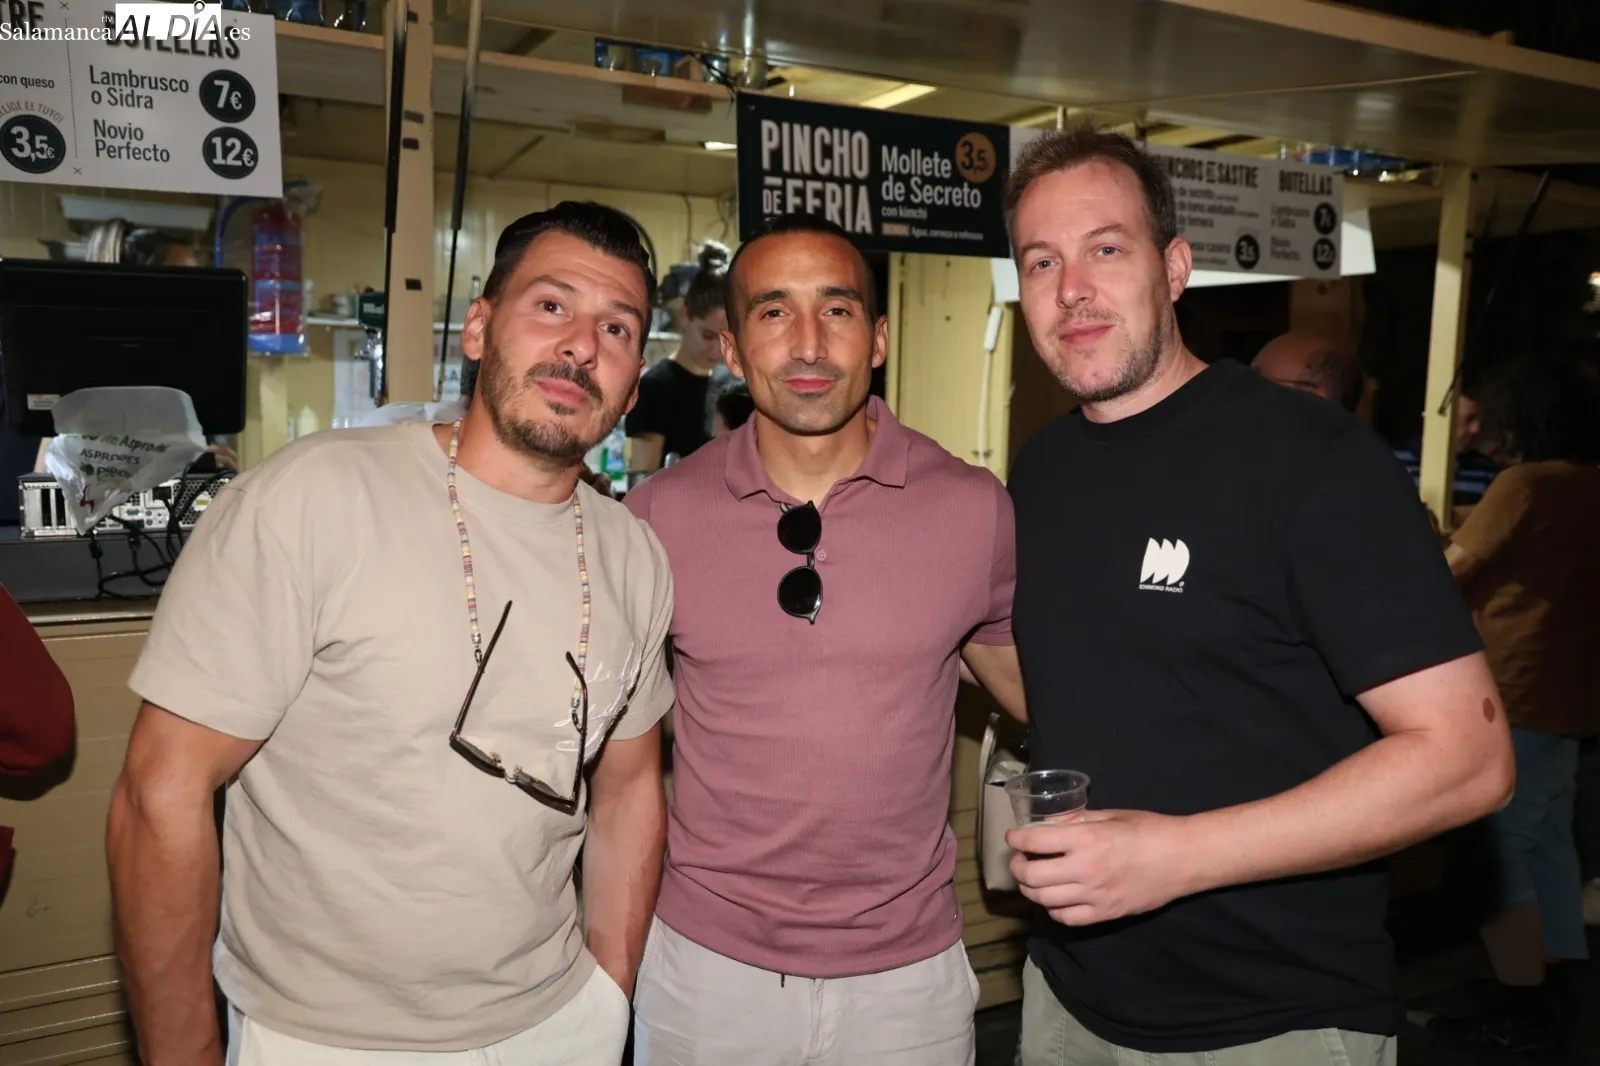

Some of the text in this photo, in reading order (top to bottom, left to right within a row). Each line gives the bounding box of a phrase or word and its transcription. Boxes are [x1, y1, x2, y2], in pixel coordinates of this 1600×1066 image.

[20, 76, 55, 89] queso
[89, 65, 189, 93] Lambrusco
[25, 101, 35, 111] EL
[91, 88, 154, 110] o Sidra
[213, 80, 242, 110] 7€
[93, 119, 144, 142] Novio
[95, 139, 170, 163] Perfecto
[211, 136, 254, 167] 12€
[760, 119, 869, 180] PINCHO
[881, 145, 952, 179] Mollete
[763, 189, 782, 215] DE
[881, 175, 981, 209] de Secreto
